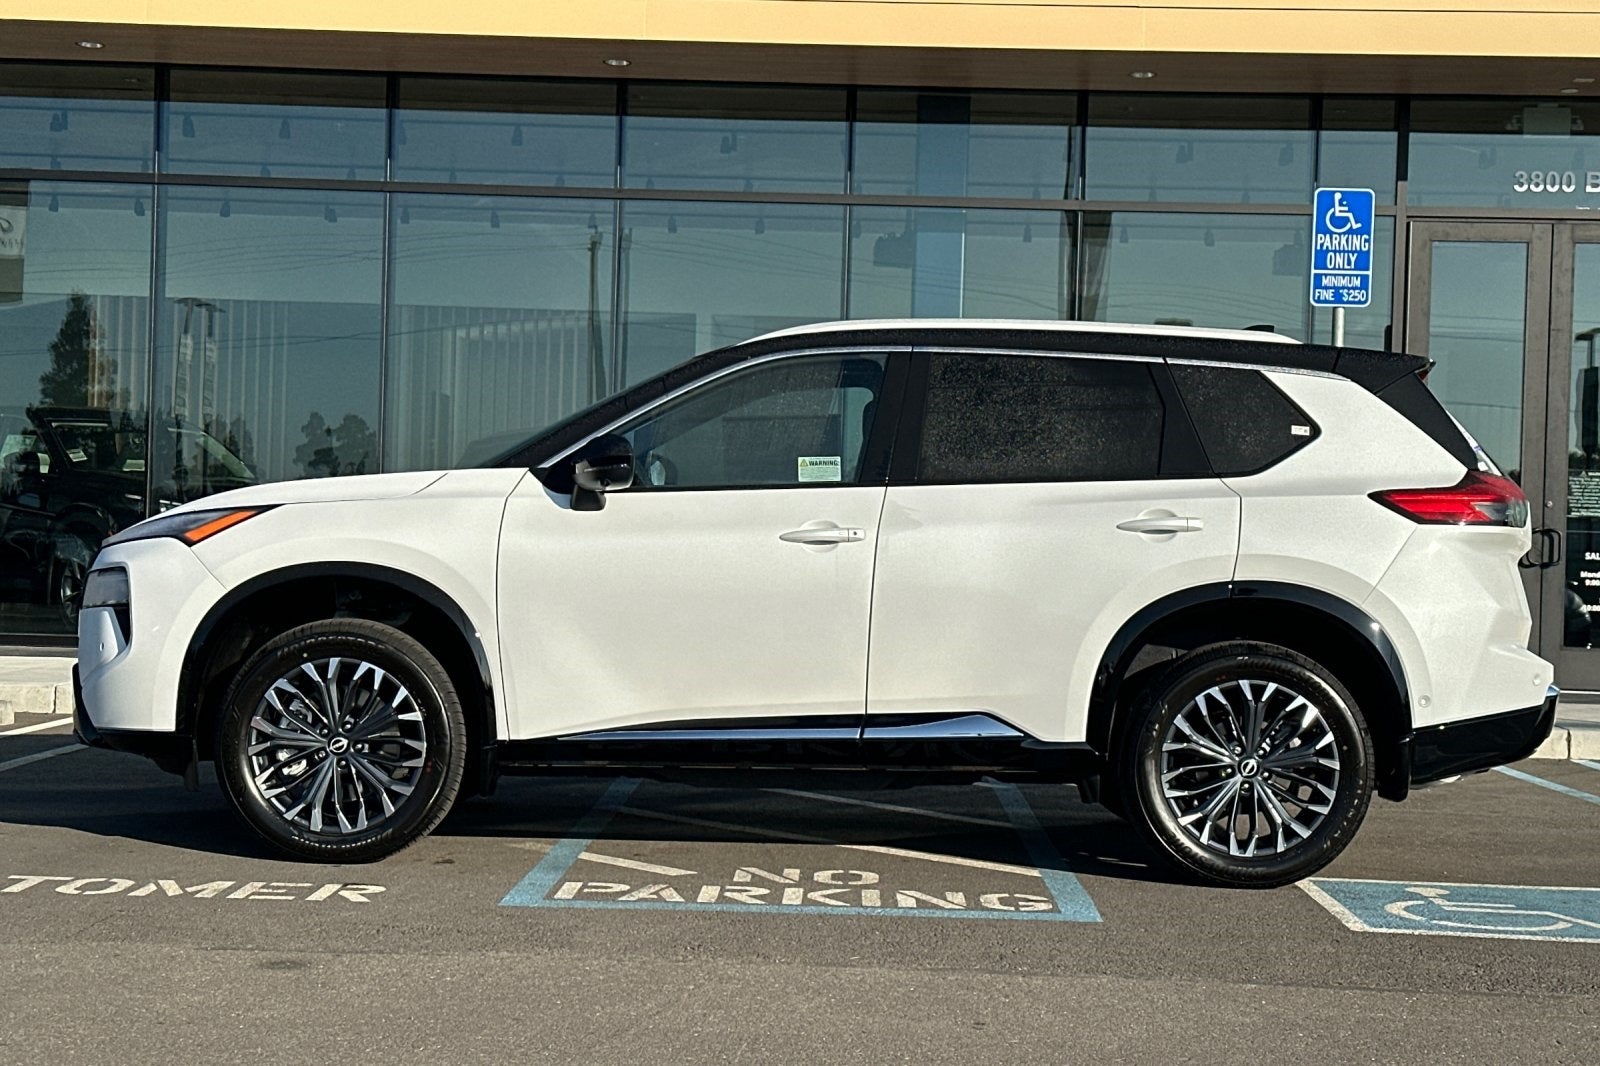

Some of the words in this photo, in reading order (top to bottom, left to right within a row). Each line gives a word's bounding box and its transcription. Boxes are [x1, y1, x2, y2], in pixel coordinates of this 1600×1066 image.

[1513, 171, 1576, 193] 3800
[1316, 234, 1369, 251] PARKING
[1326, 252, 1358, 269] ONLY
[1322, 275, 1361, 287] MINIMUM
[1314, 289, 1335, 301] FINE
[732, 867, 880, 886] NO
[0, 875, 387, 903] TOMER
[553, 881, 1053, 911] PARKING
